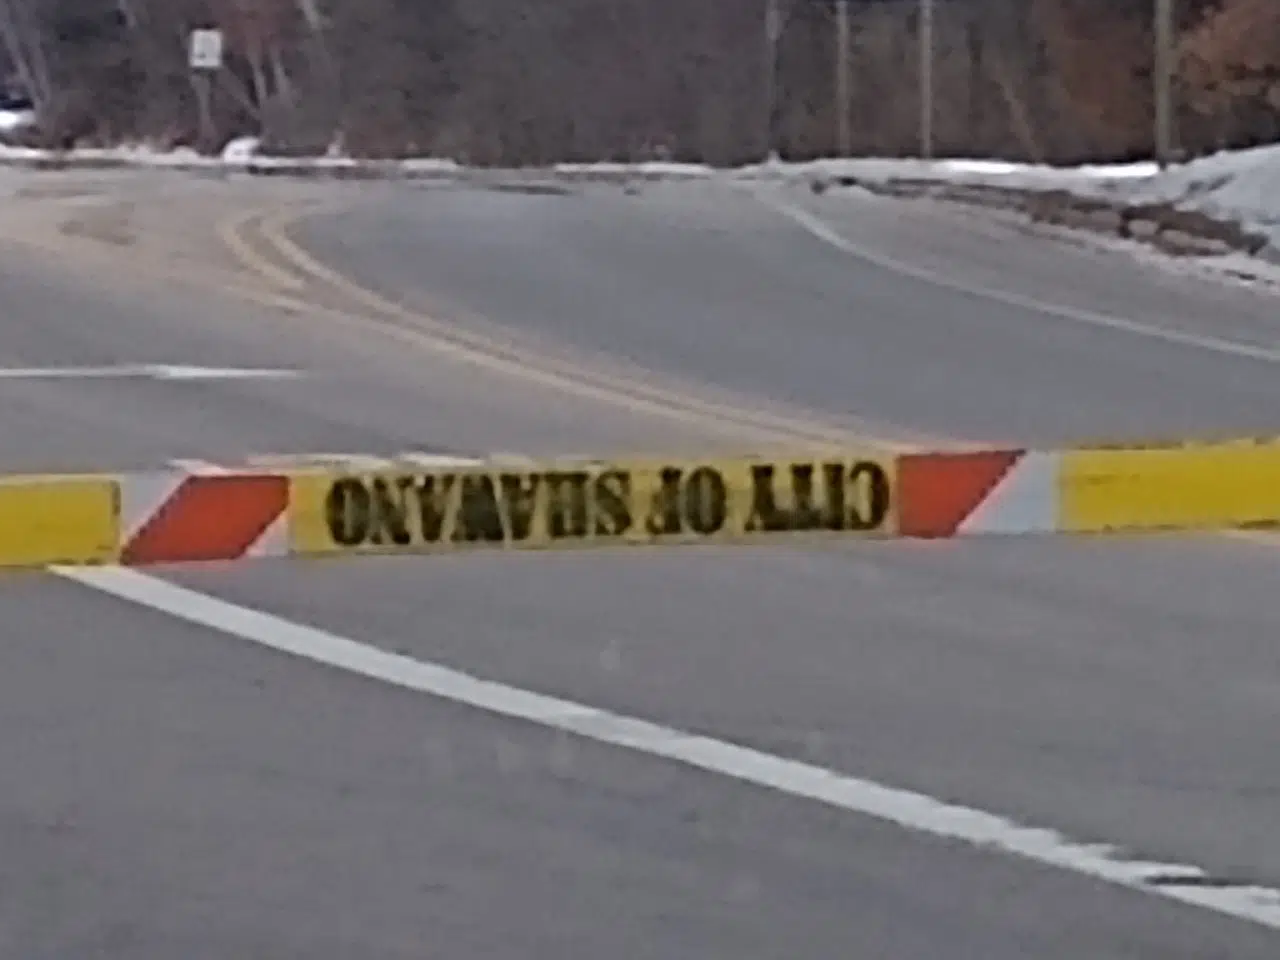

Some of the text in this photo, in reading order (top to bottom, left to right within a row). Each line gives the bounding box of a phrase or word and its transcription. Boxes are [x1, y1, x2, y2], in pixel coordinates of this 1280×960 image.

[325, 459, 891, 546] CITY OF SHAWANO
